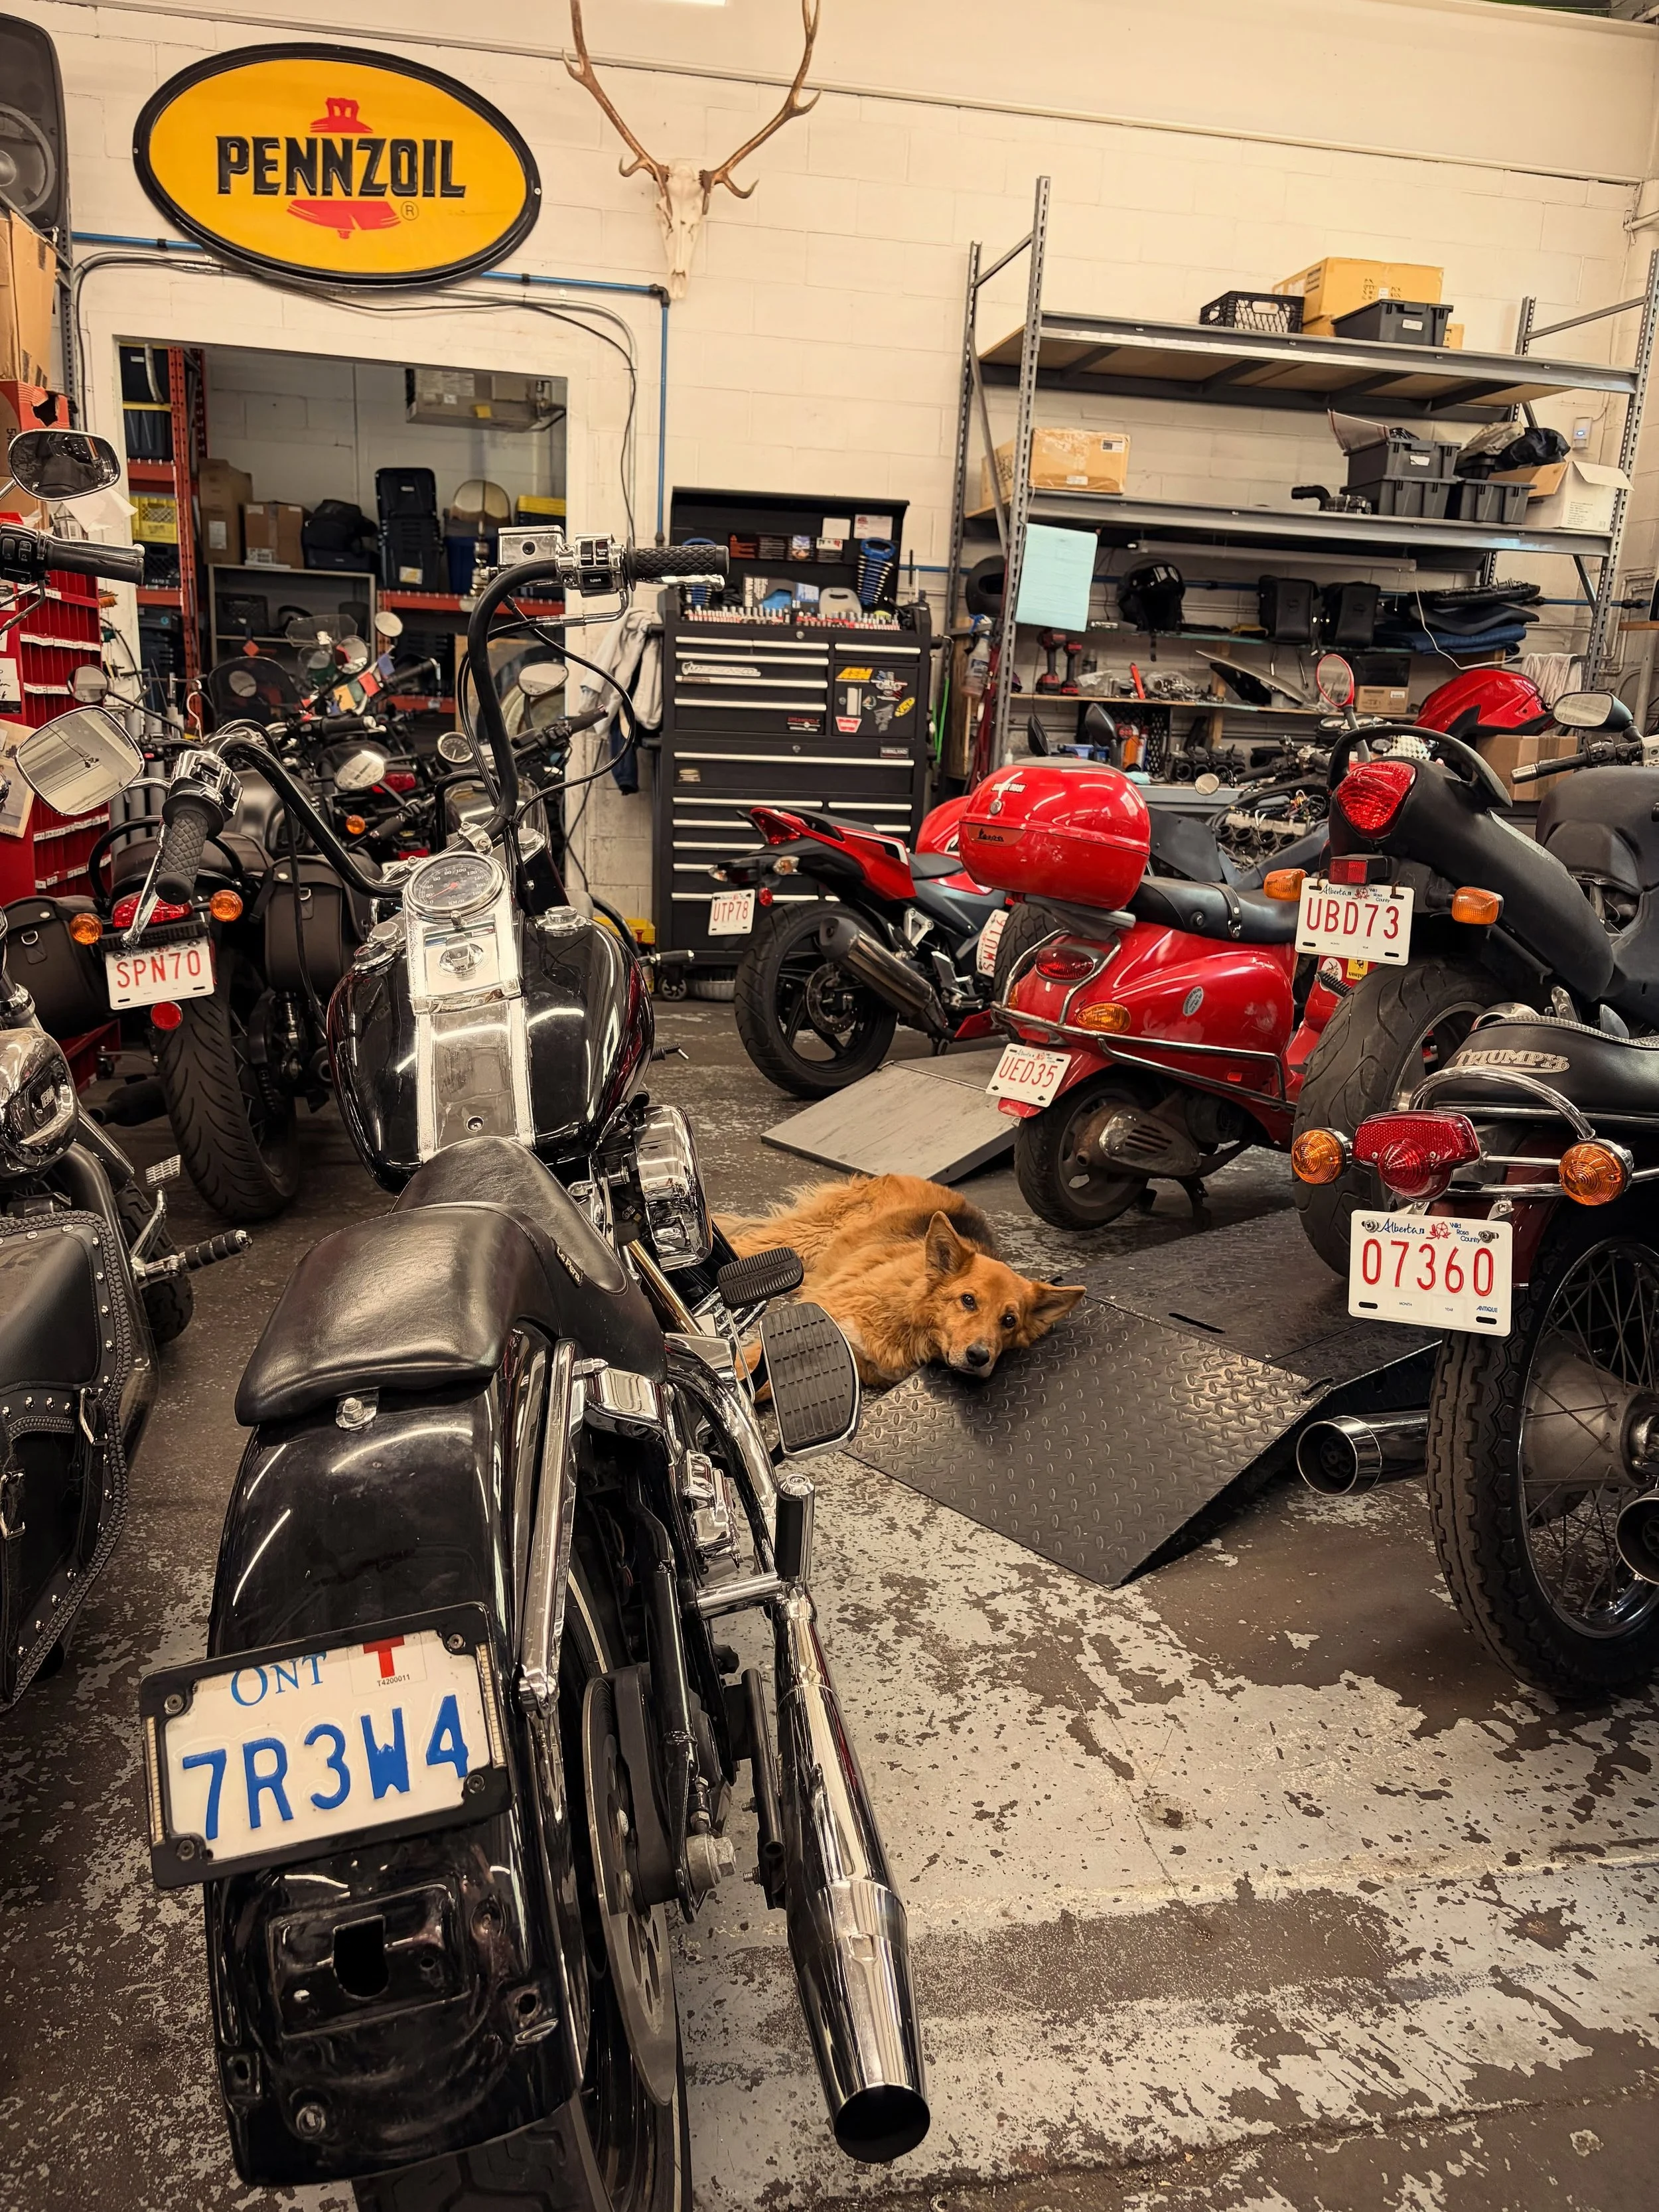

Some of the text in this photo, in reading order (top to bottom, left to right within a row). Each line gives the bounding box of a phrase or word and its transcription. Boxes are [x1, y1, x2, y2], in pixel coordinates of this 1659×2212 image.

[216, 135, 467, 198] PENNZOIL
[977, 828, 1004, 842] Vespa
[1319, 884, 1348, 896] Alberta
[713, 901, 749, 922] UTP78
[1307, 897, 1399, 939] UBD73
[117, 950, 200, 988] SPN70
[999, 1056, 1058, 1087] UED35
[1455, 1049, 1571, 1070] TRIUMPH
[1377, 1218, 1421, 1235] Alberta
[1362, 1238, 1494, 1297] 07360
[1477, 1305, 1498, 1313] ANTIQUE
[230, 1651, 327, 1706] ONT
[377, 1673, 411, 1688] T4200011
[182, 1694, 469, 1841] 7R3W4
